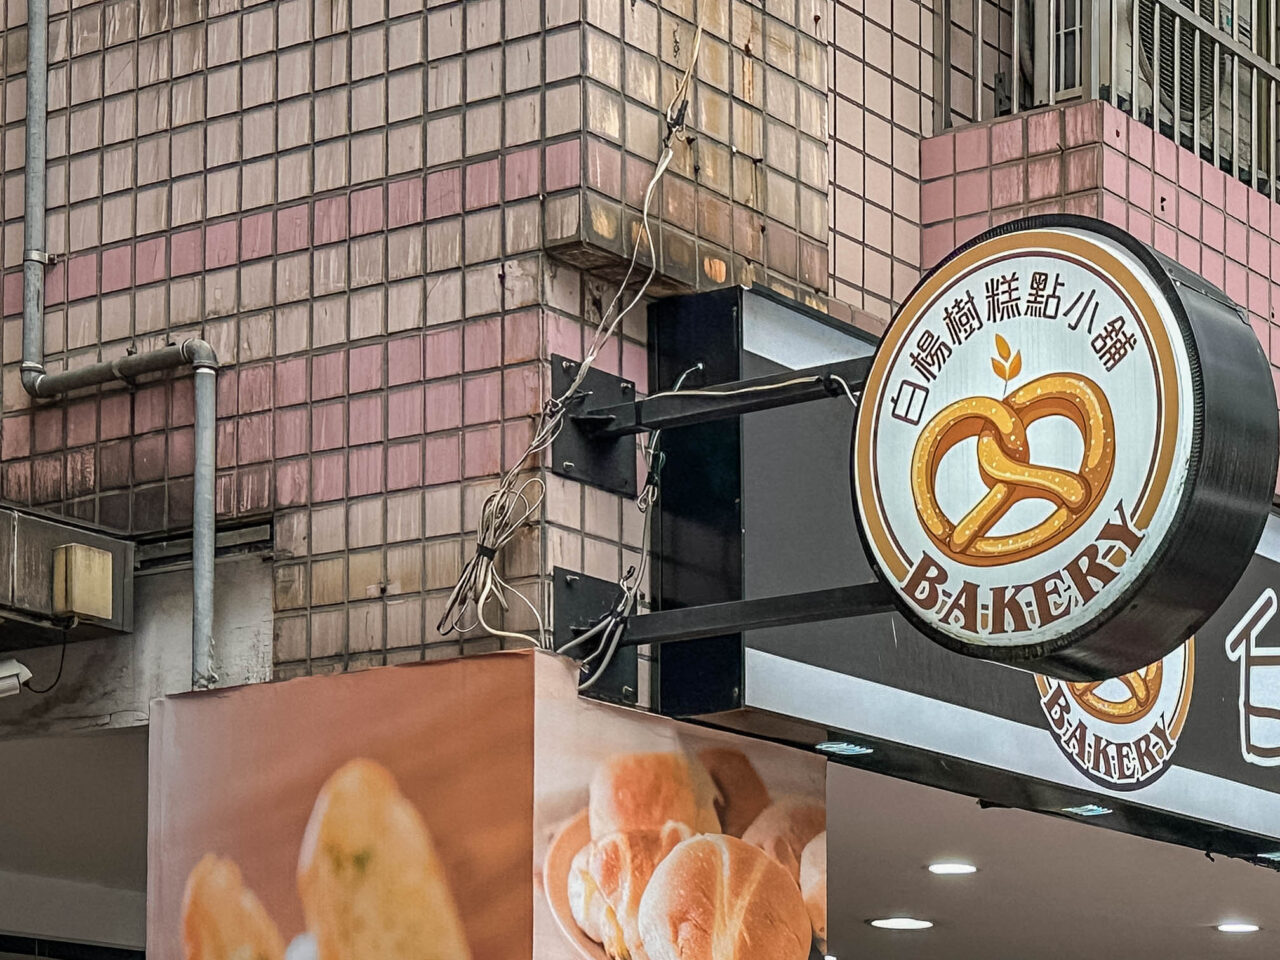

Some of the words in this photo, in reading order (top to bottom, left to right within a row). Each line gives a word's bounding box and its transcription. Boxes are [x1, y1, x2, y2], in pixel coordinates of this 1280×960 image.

[892, 271, 1138, 426] 白楊樹糕點小舖
[901, 498, 1146, 634] BAKERY
[1044, 682, 1174, 781] BAKERY
